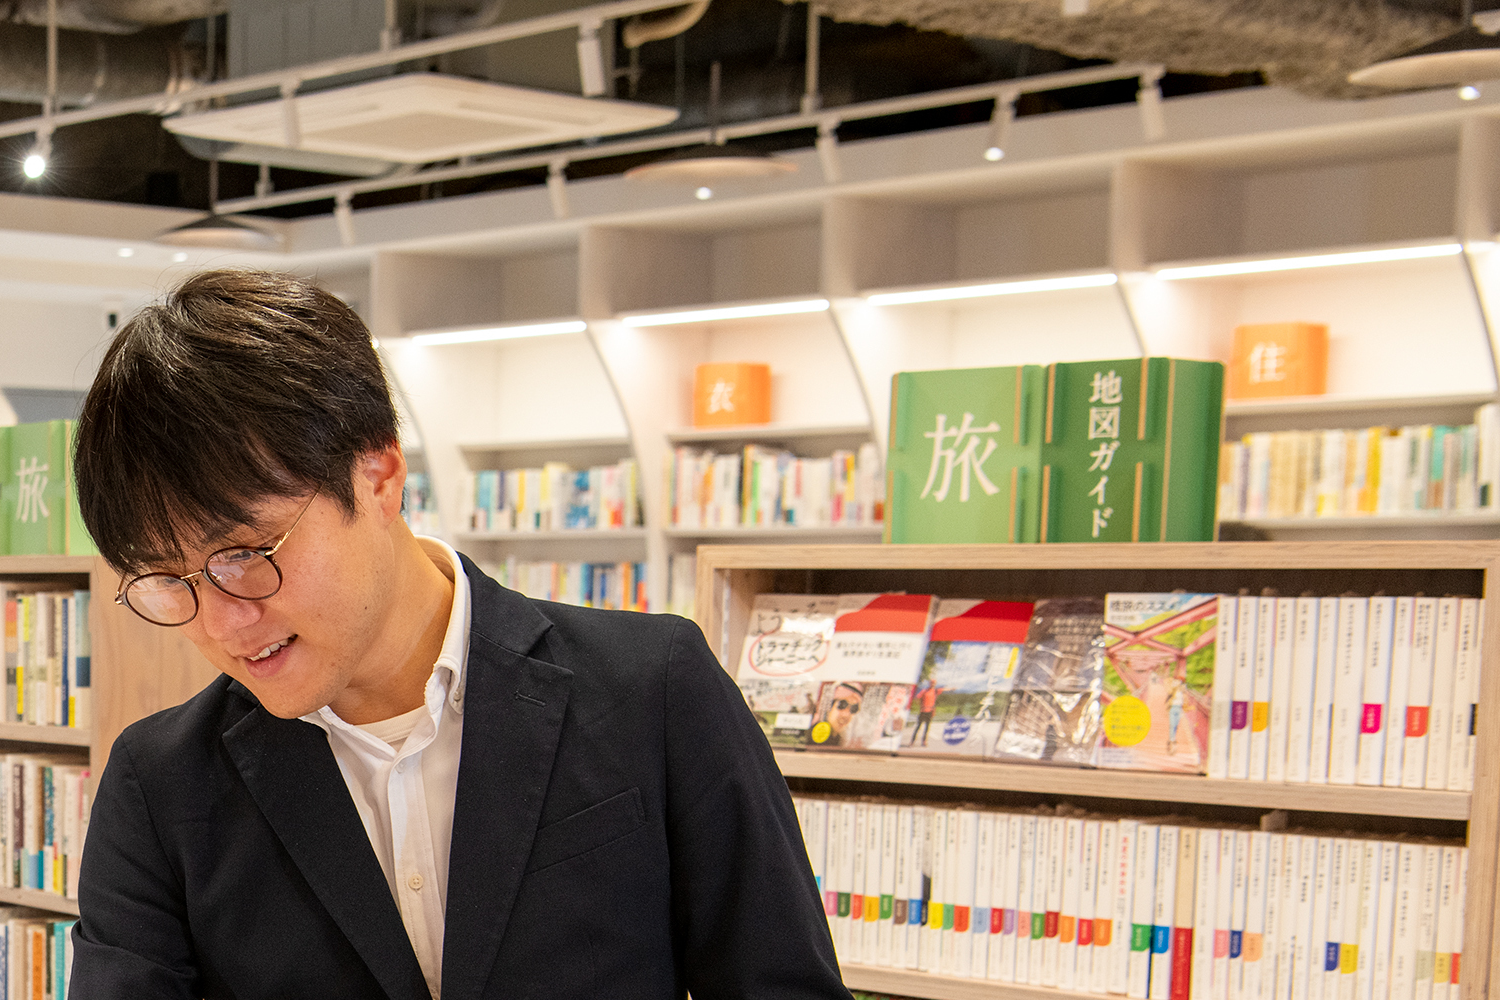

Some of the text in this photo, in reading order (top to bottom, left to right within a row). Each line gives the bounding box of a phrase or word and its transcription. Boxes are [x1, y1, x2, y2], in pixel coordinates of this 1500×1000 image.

[1248, 341, 1287, 384] 住
[15, 455, 49, 523] 旅
[921, 412, 1000, 503] 旅
[1088, 370, 1123, 538] 地図ガイド
